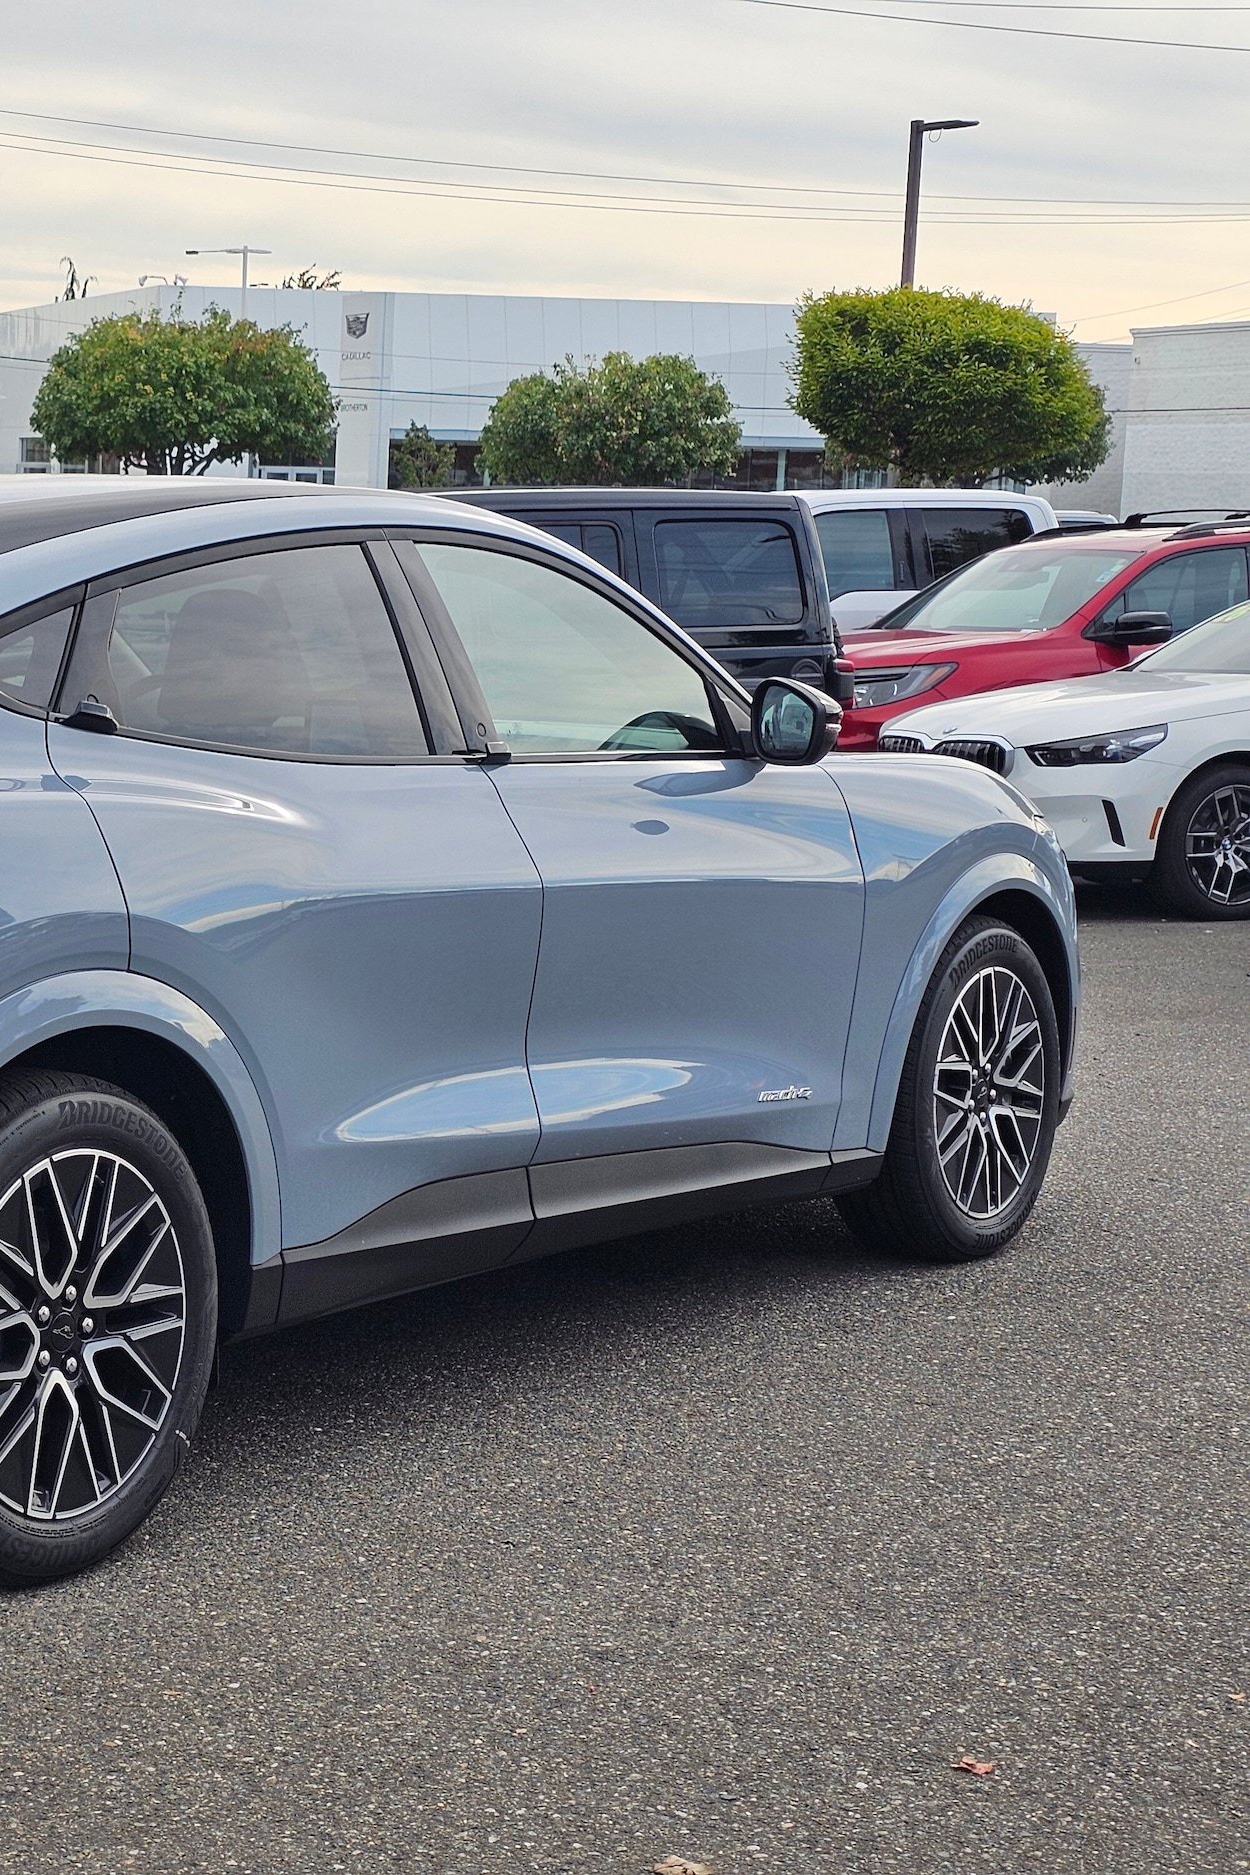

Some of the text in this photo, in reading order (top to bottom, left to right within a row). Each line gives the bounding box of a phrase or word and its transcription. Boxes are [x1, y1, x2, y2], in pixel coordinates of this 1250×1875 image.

[341, 351, 371, 361] CADILLAC
[949, 934, 1019, 991] BRIDGESTONE
[58, 1100, 188, 1182] BRIDGESTONE
